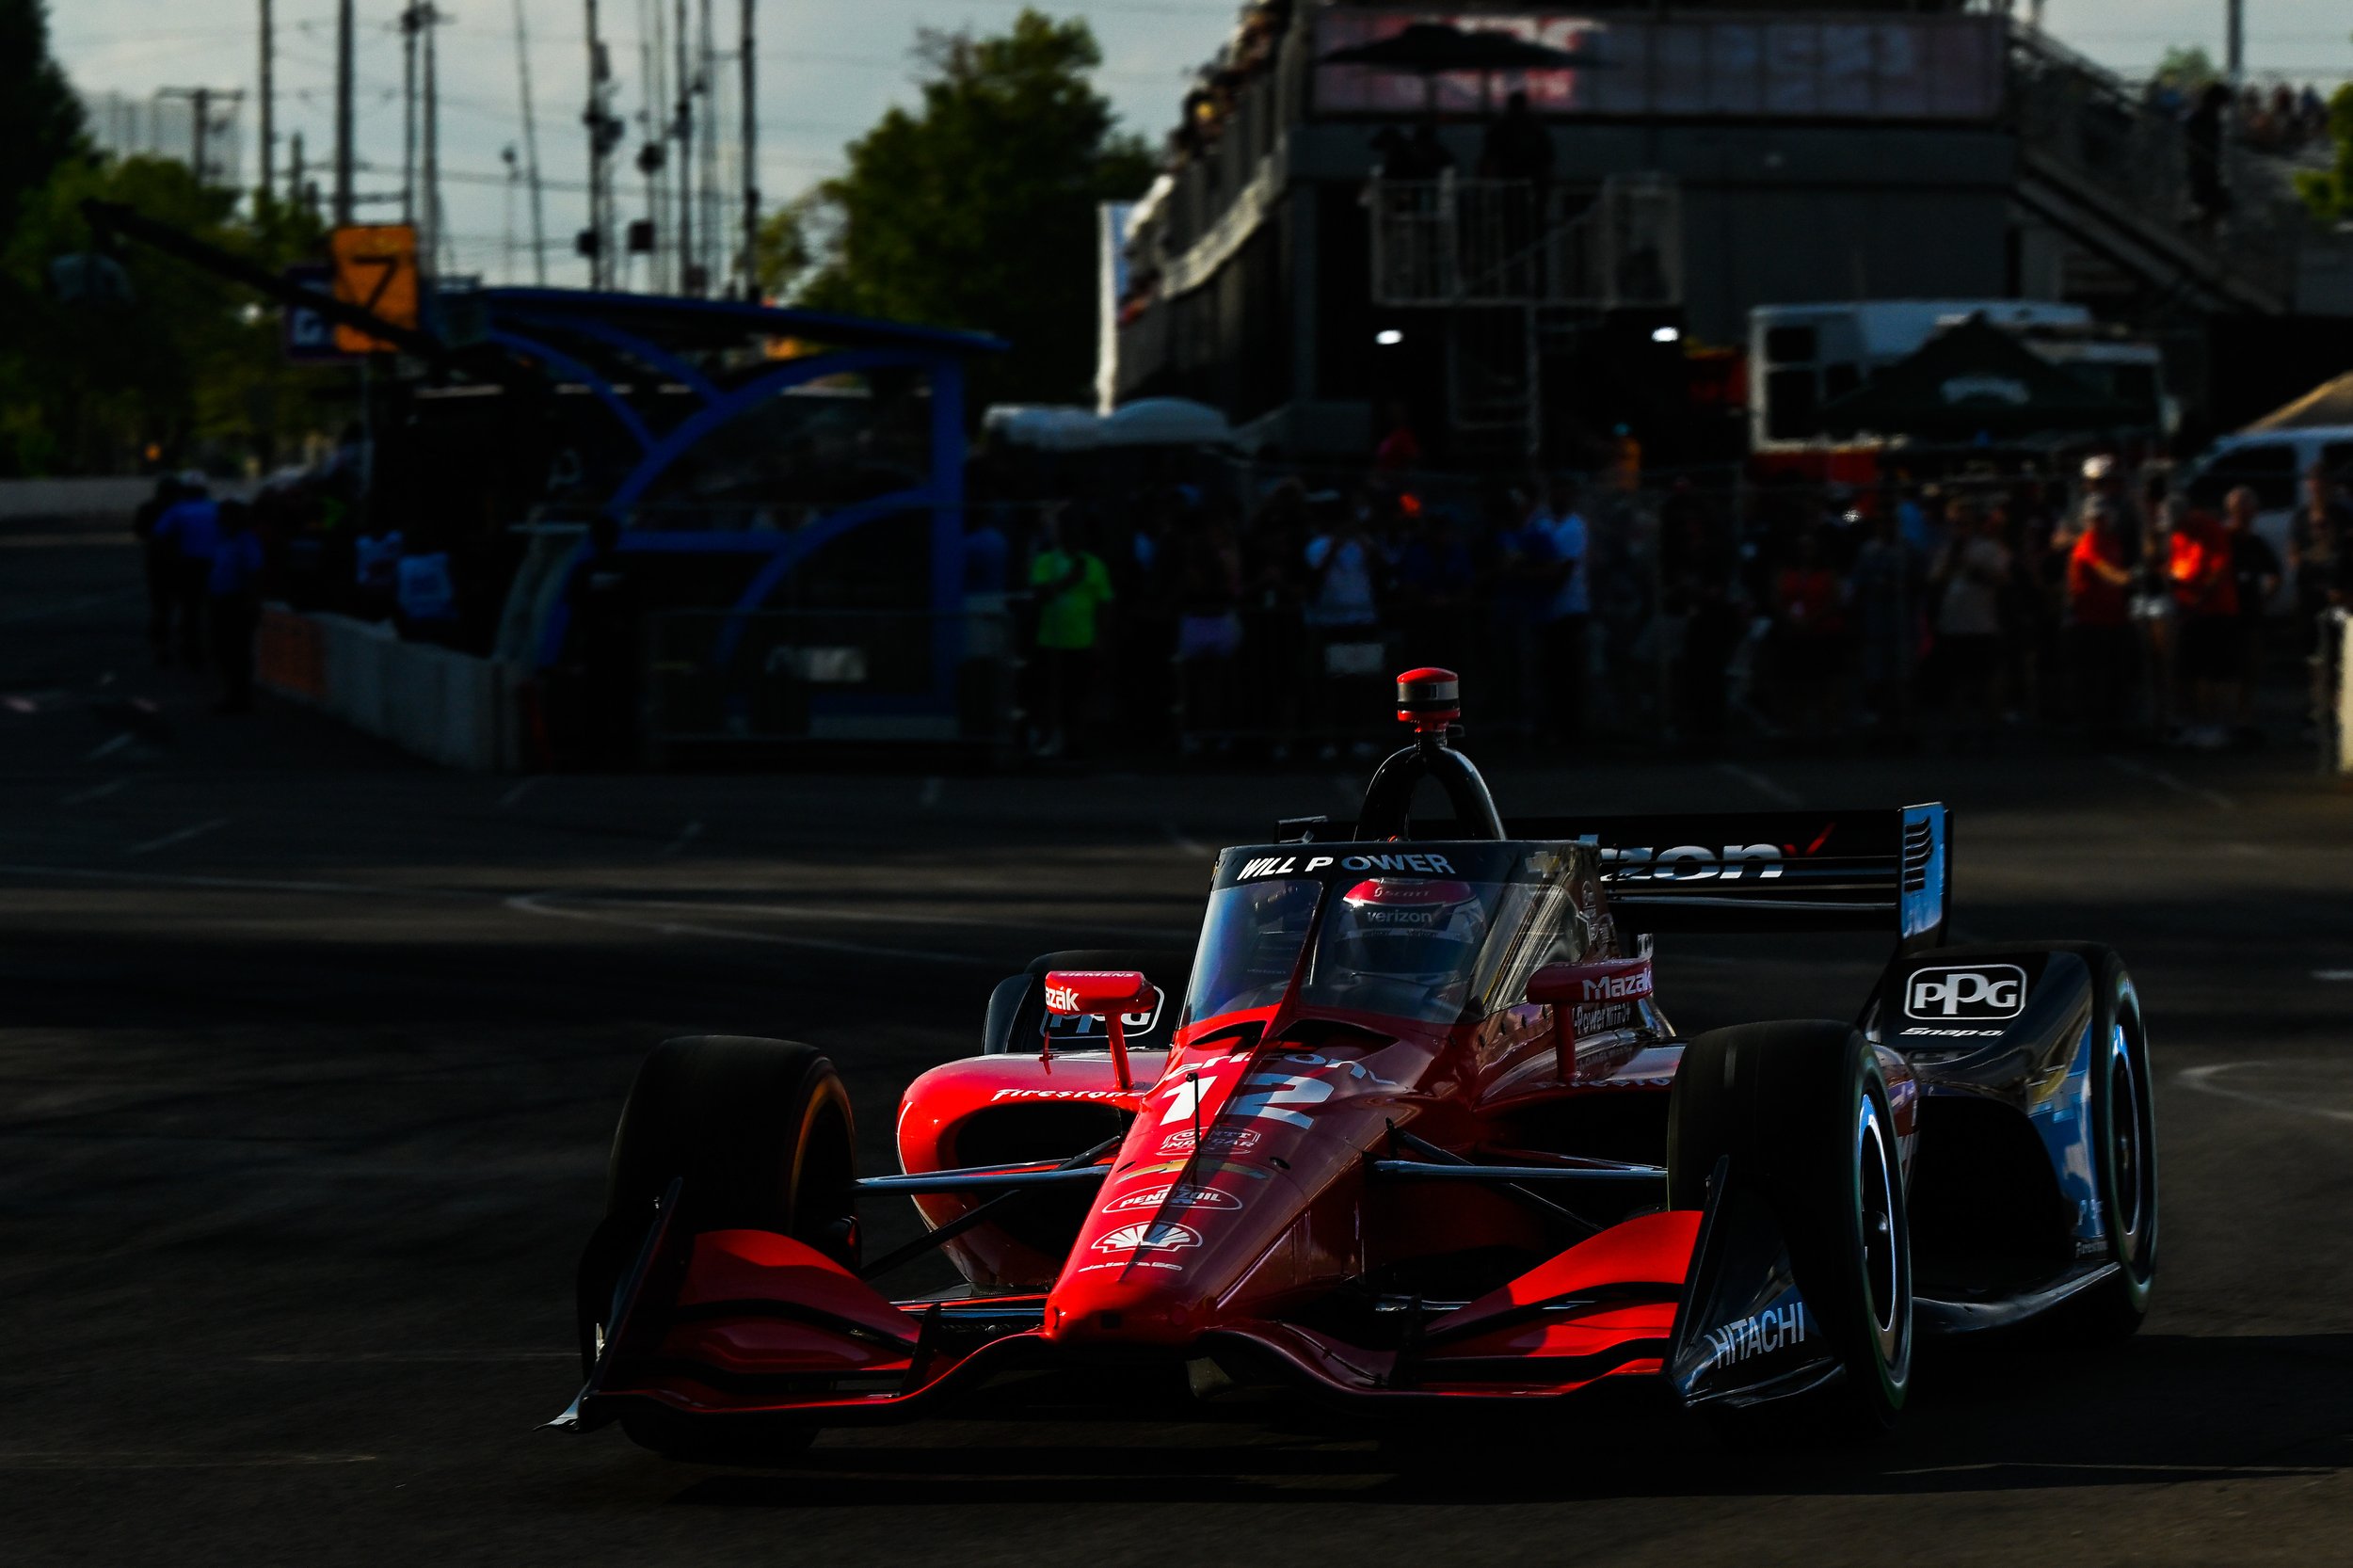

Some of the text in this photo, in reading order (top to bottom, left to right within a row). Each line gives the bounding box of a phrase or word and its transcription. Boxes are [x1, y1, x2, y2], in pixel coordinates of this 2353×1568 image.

[353, 255, 399, 312] 7
[1237, 853, 1457, 881] WILL POWER
[1367, 908, 1433, 923] verizon
[1913, 973, 2019, 1016] PPG
[1159, 1073, 1335, 1130] 12
[1119, 1191, 1222, 1208] PENZOIL
[1704, 1302, 1805, 1369] HITACHI
